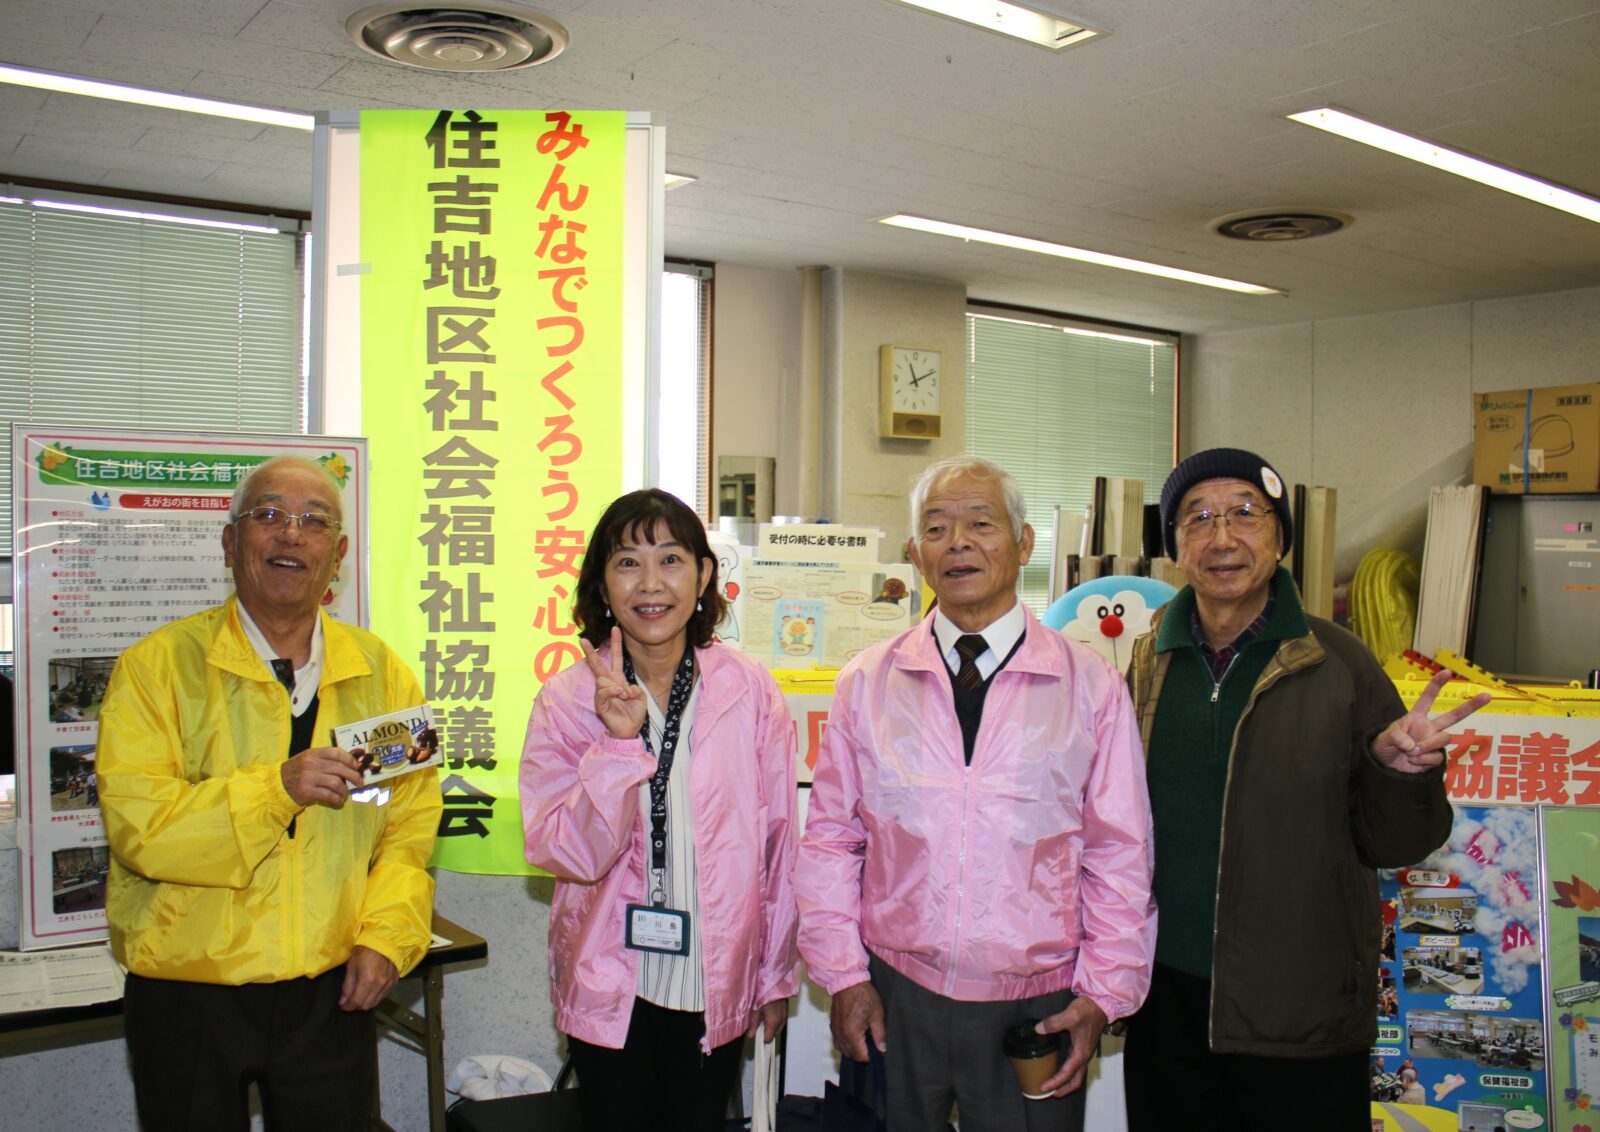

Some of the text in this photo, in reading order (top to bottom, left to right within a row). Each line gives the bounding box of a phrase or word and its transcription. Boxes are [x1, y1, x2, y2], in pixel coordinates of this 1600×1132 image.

[418, 110, 501, 838] 住吉地区社会福祉協議会
[532, 111, 590, 684] みんなでつくろう安心の
[769, 533, 867, 548] 受付の時に必要な書類
[351, 717, 422, 747] ALMOND
